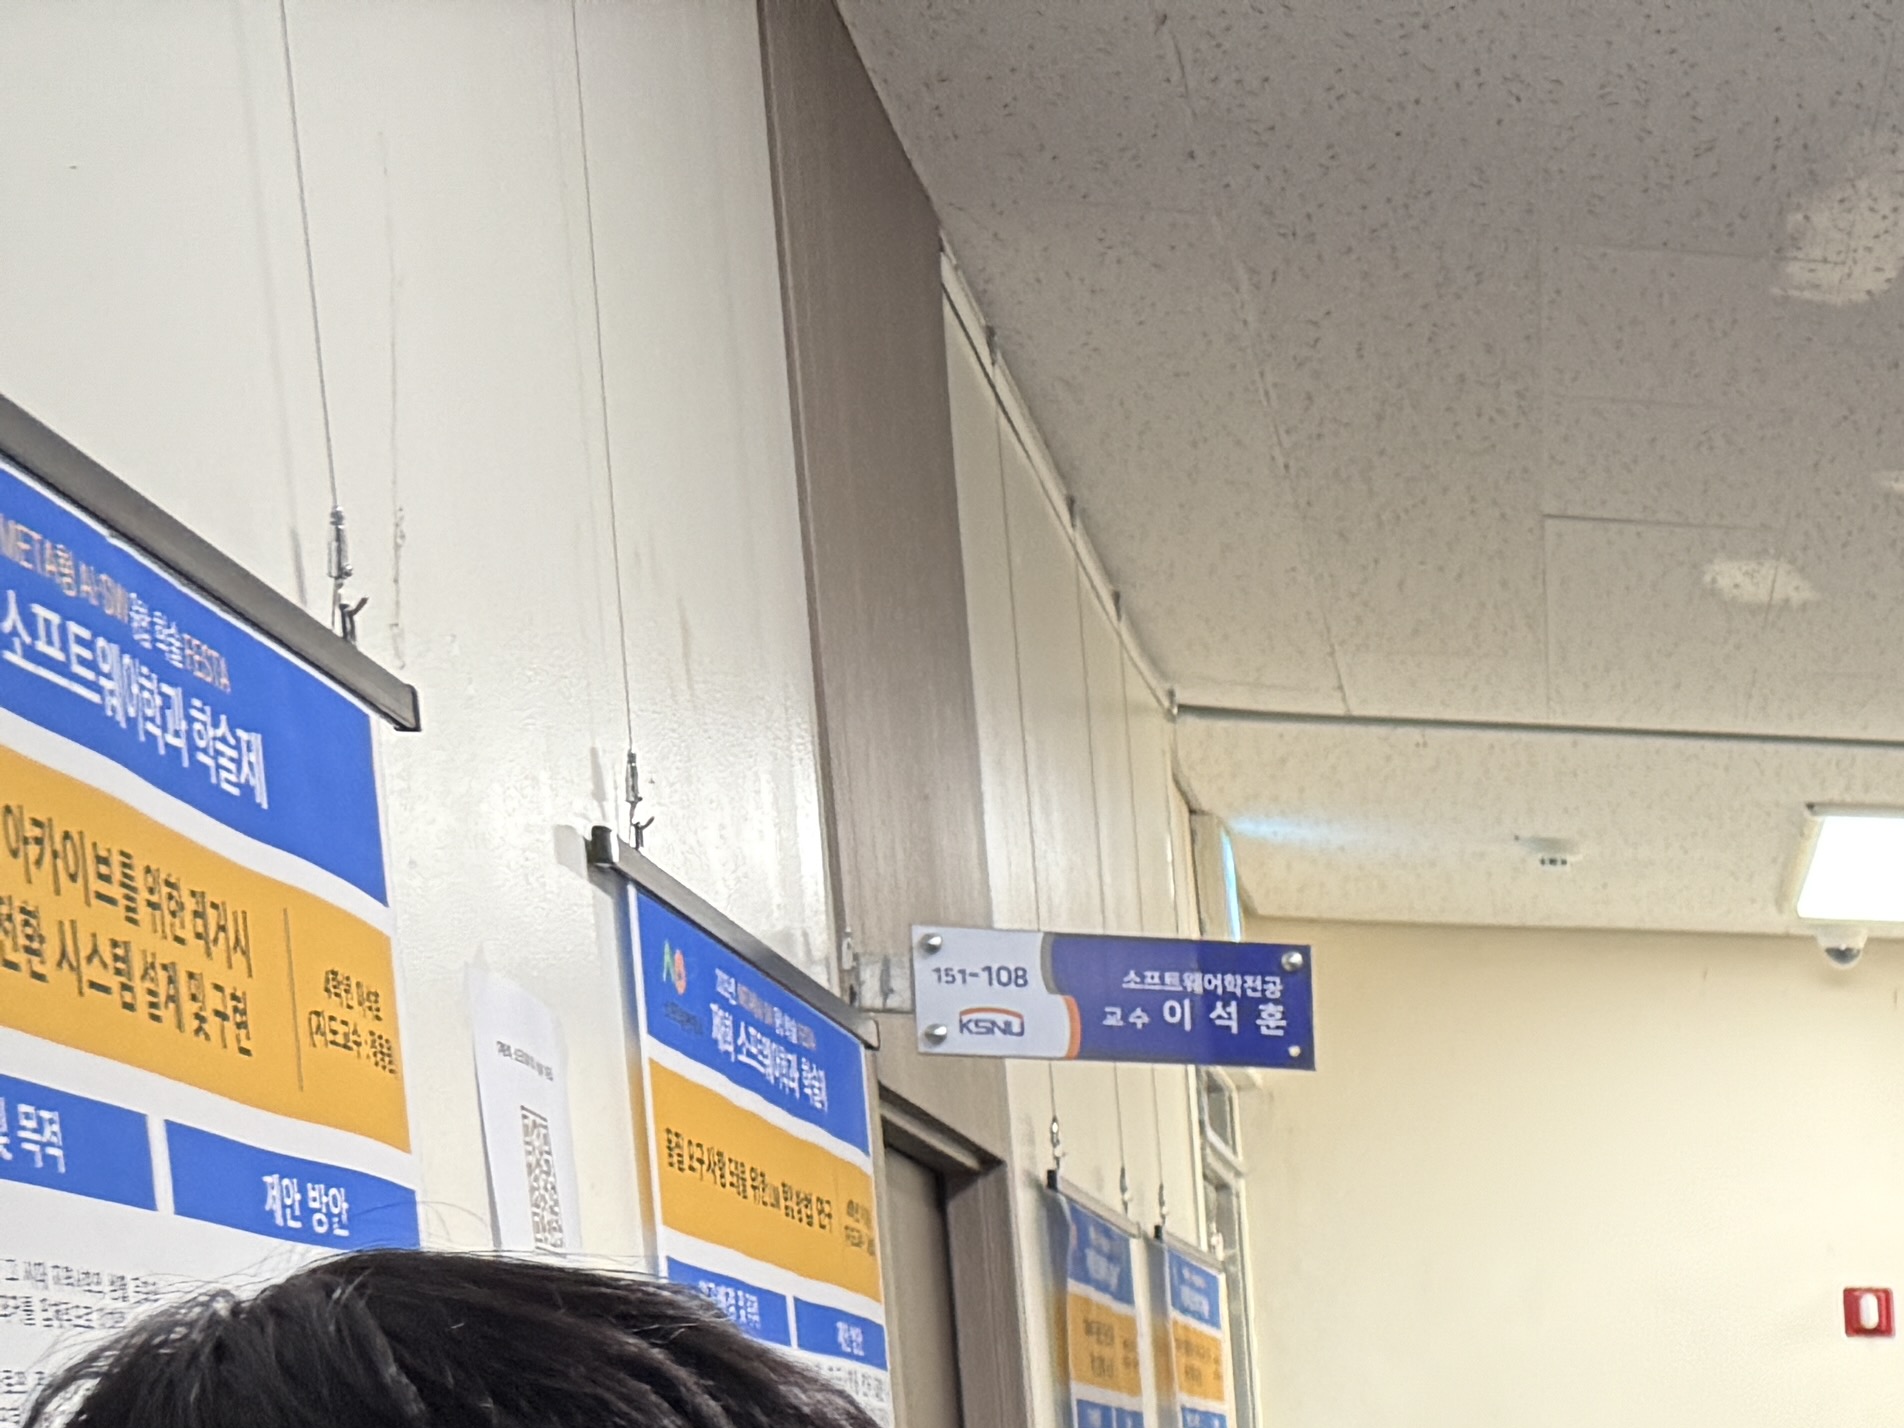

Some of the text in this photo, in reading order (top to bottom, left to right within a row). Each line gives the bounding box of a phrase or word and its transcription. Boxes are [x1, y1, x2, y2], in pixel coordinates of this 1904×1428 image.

[1, 589, 268, 810] 소프트웨어학과 학술제
[3, 805, 253, 978] 아카이브를 위한 레거시
[57, 919, 136, 1012] 시스템
[141, 948, 185, 1033] 설계
[185, 970, 210, 1042] 및
[211, 982, 253, 1057] 구현
[931, 965, 1028, 988] 151-108
[1122, 970, 1284, 999] 소프트웨어학전공
[959, 1016, 1025, 1037] KSNU
[1102, 998, 1287, 1037] 교수 이 석 훈
[16, 1103, 66, 1174] 목적
[261, 1173, 350, 1237] 제안 방안
